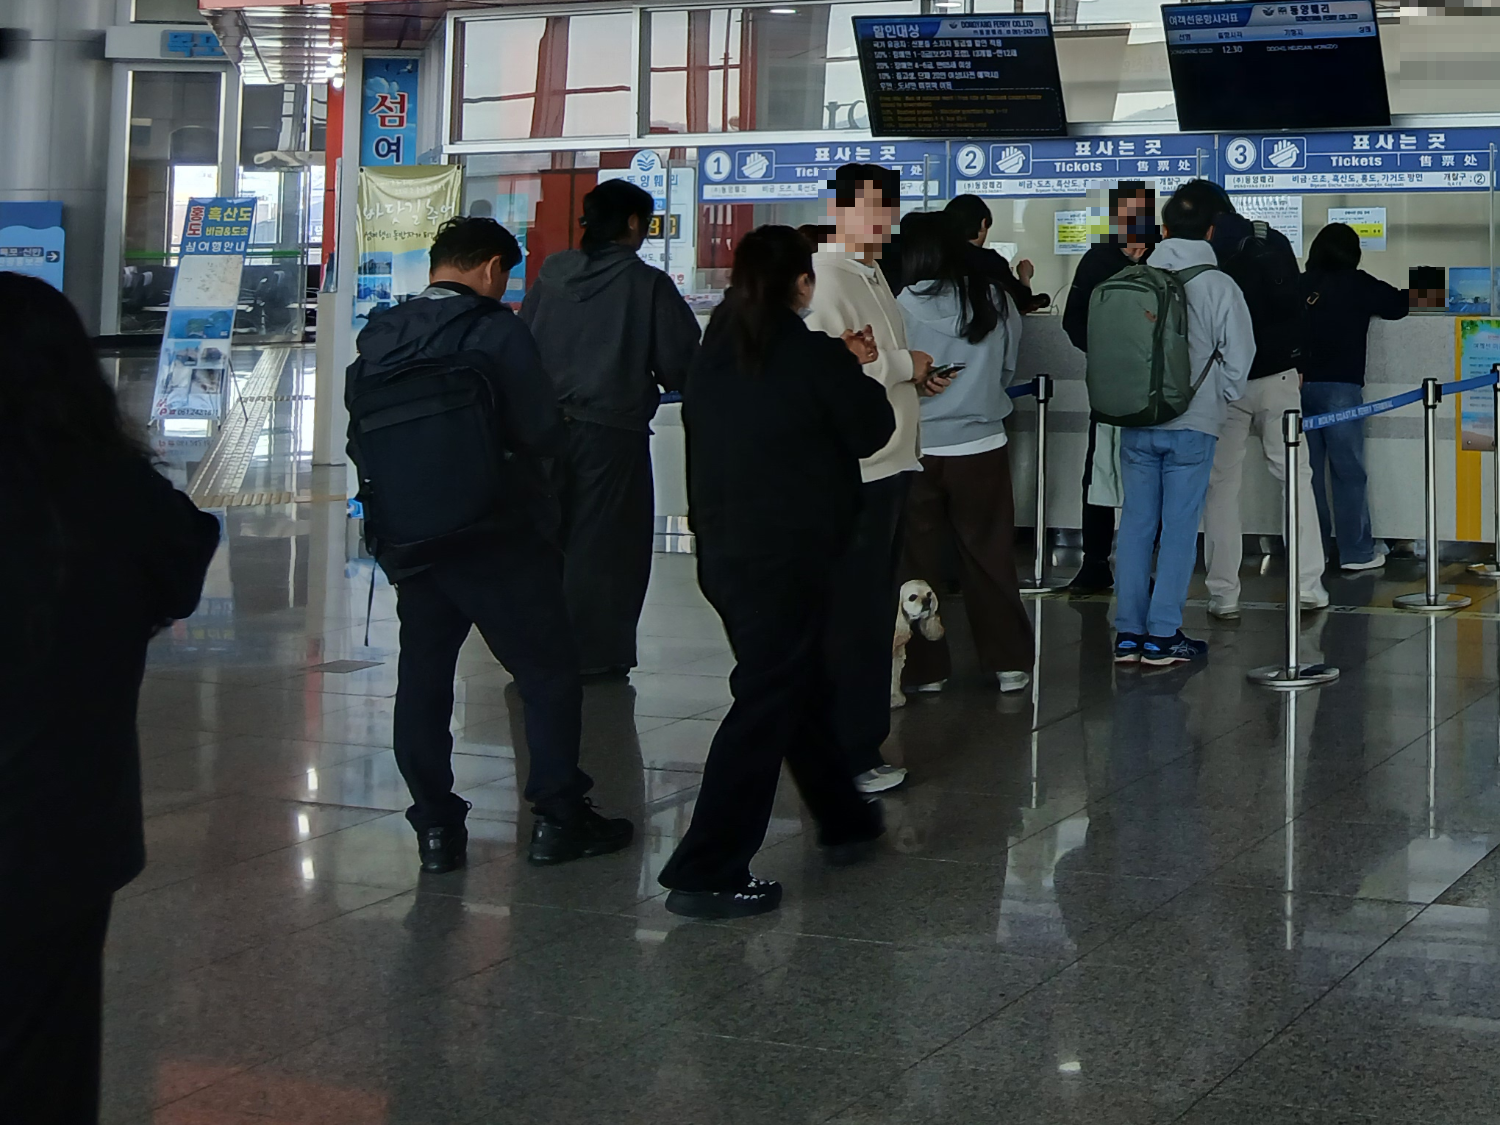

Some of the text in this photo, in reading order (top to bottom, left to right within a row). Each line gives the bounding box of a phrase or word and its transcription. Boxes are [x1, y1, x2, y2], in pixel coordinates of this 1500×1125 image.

[1169, 14, 1239, 26] 여객선운항시각표
[873, 25, 919, 38] 할인대상
[1330, 155, 1382, 167] Tickets
[1054, 162, 1102, 173] Tickets
[208, 207, 252, 221] 흑산도
